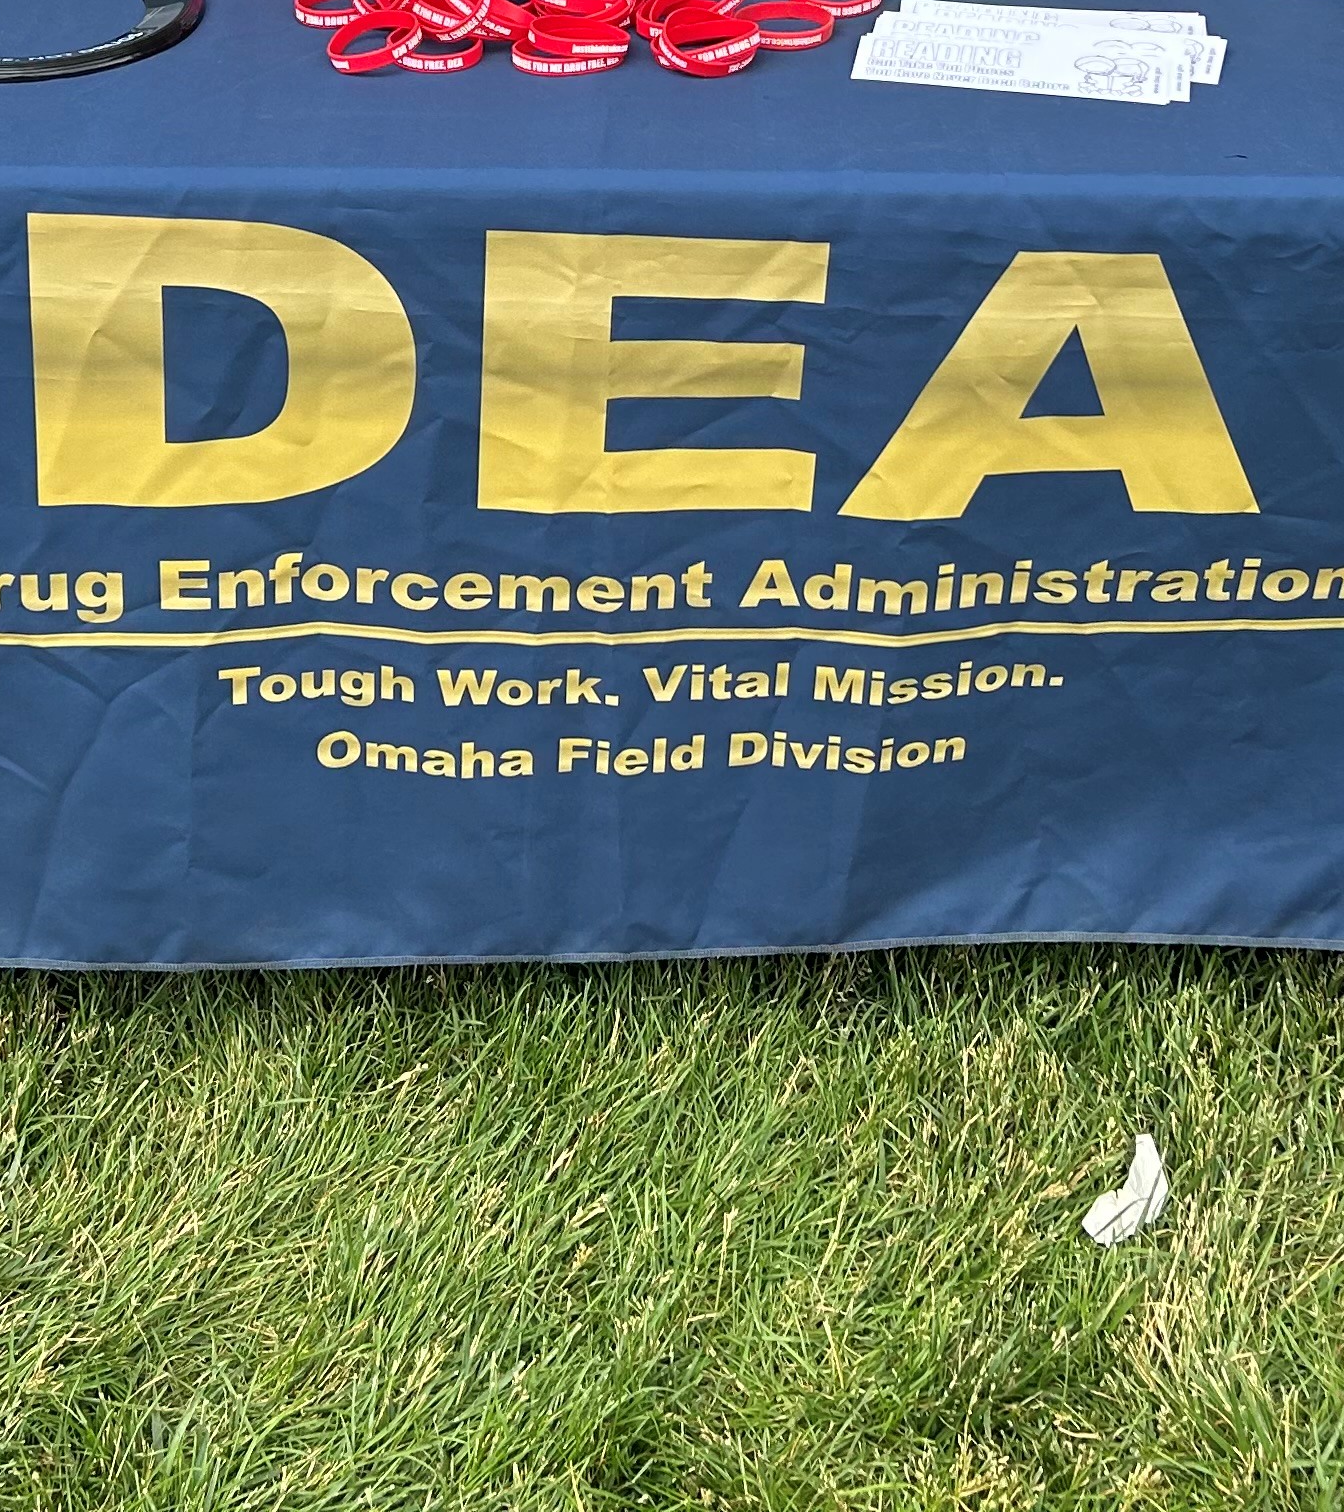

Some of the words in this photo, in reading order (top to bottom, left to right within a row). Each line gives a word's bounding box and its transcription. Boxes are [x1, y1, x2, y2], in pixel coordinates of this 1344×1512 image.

[871, 40, 1022, 68] READING
[27, 212, 1261, 521] DEA
[158, 552, 713, 614] Enforcement
[218, 665, 415, 707] Tough
[436, 668, 620, 707] Work.
[643, 662, 790, 703] Vital
[813, 661, 1065, 707] Mission.
[316, 729, 535, 779] Omaha
[557, 733, 705, 776] Field
[728, 730, 968, 775] Division
